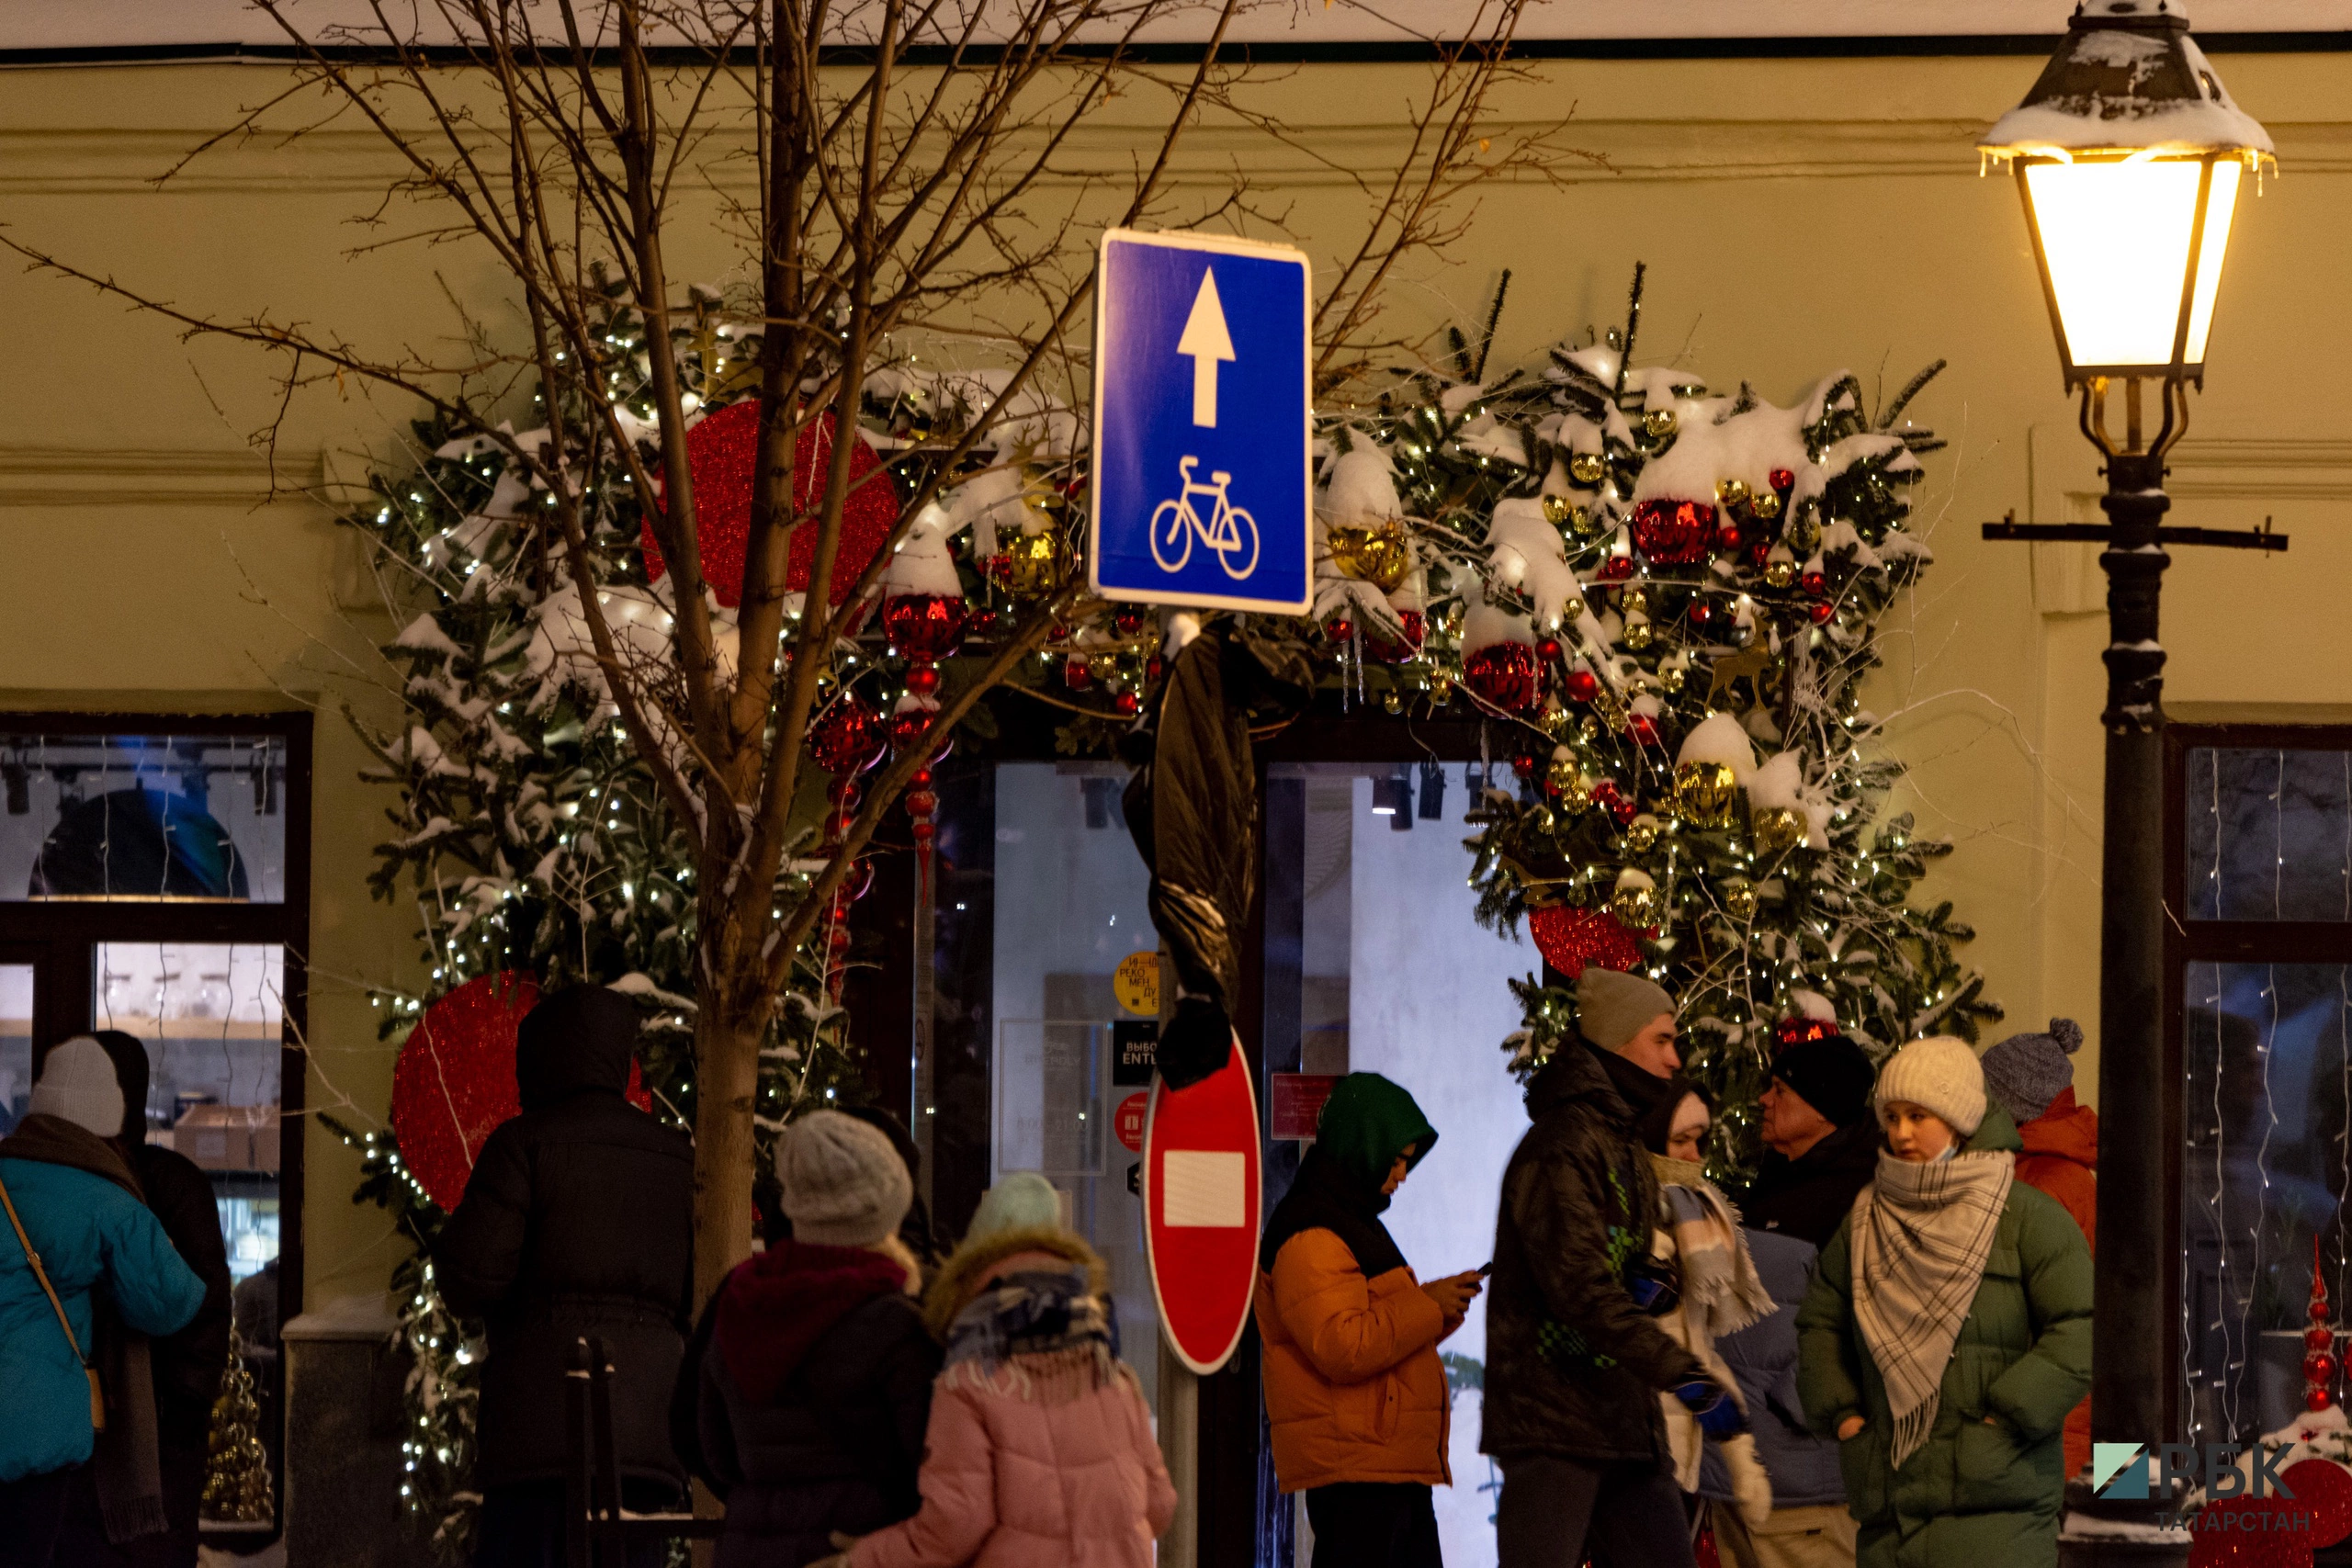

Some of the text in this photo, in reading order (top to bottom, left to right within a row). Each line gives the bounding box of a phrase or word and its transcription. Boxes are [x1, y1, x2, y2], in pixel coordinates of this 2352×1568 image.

[1119, 968, 1146, 978] РЕКО
[1129, 977, 1149, 987] МЕН
[1143, 987, 1157, 998] ДУ
[1125, 1040, 1159, 1053] ВЫБО
[1122, 1052, 1158, 1066] ENTE
